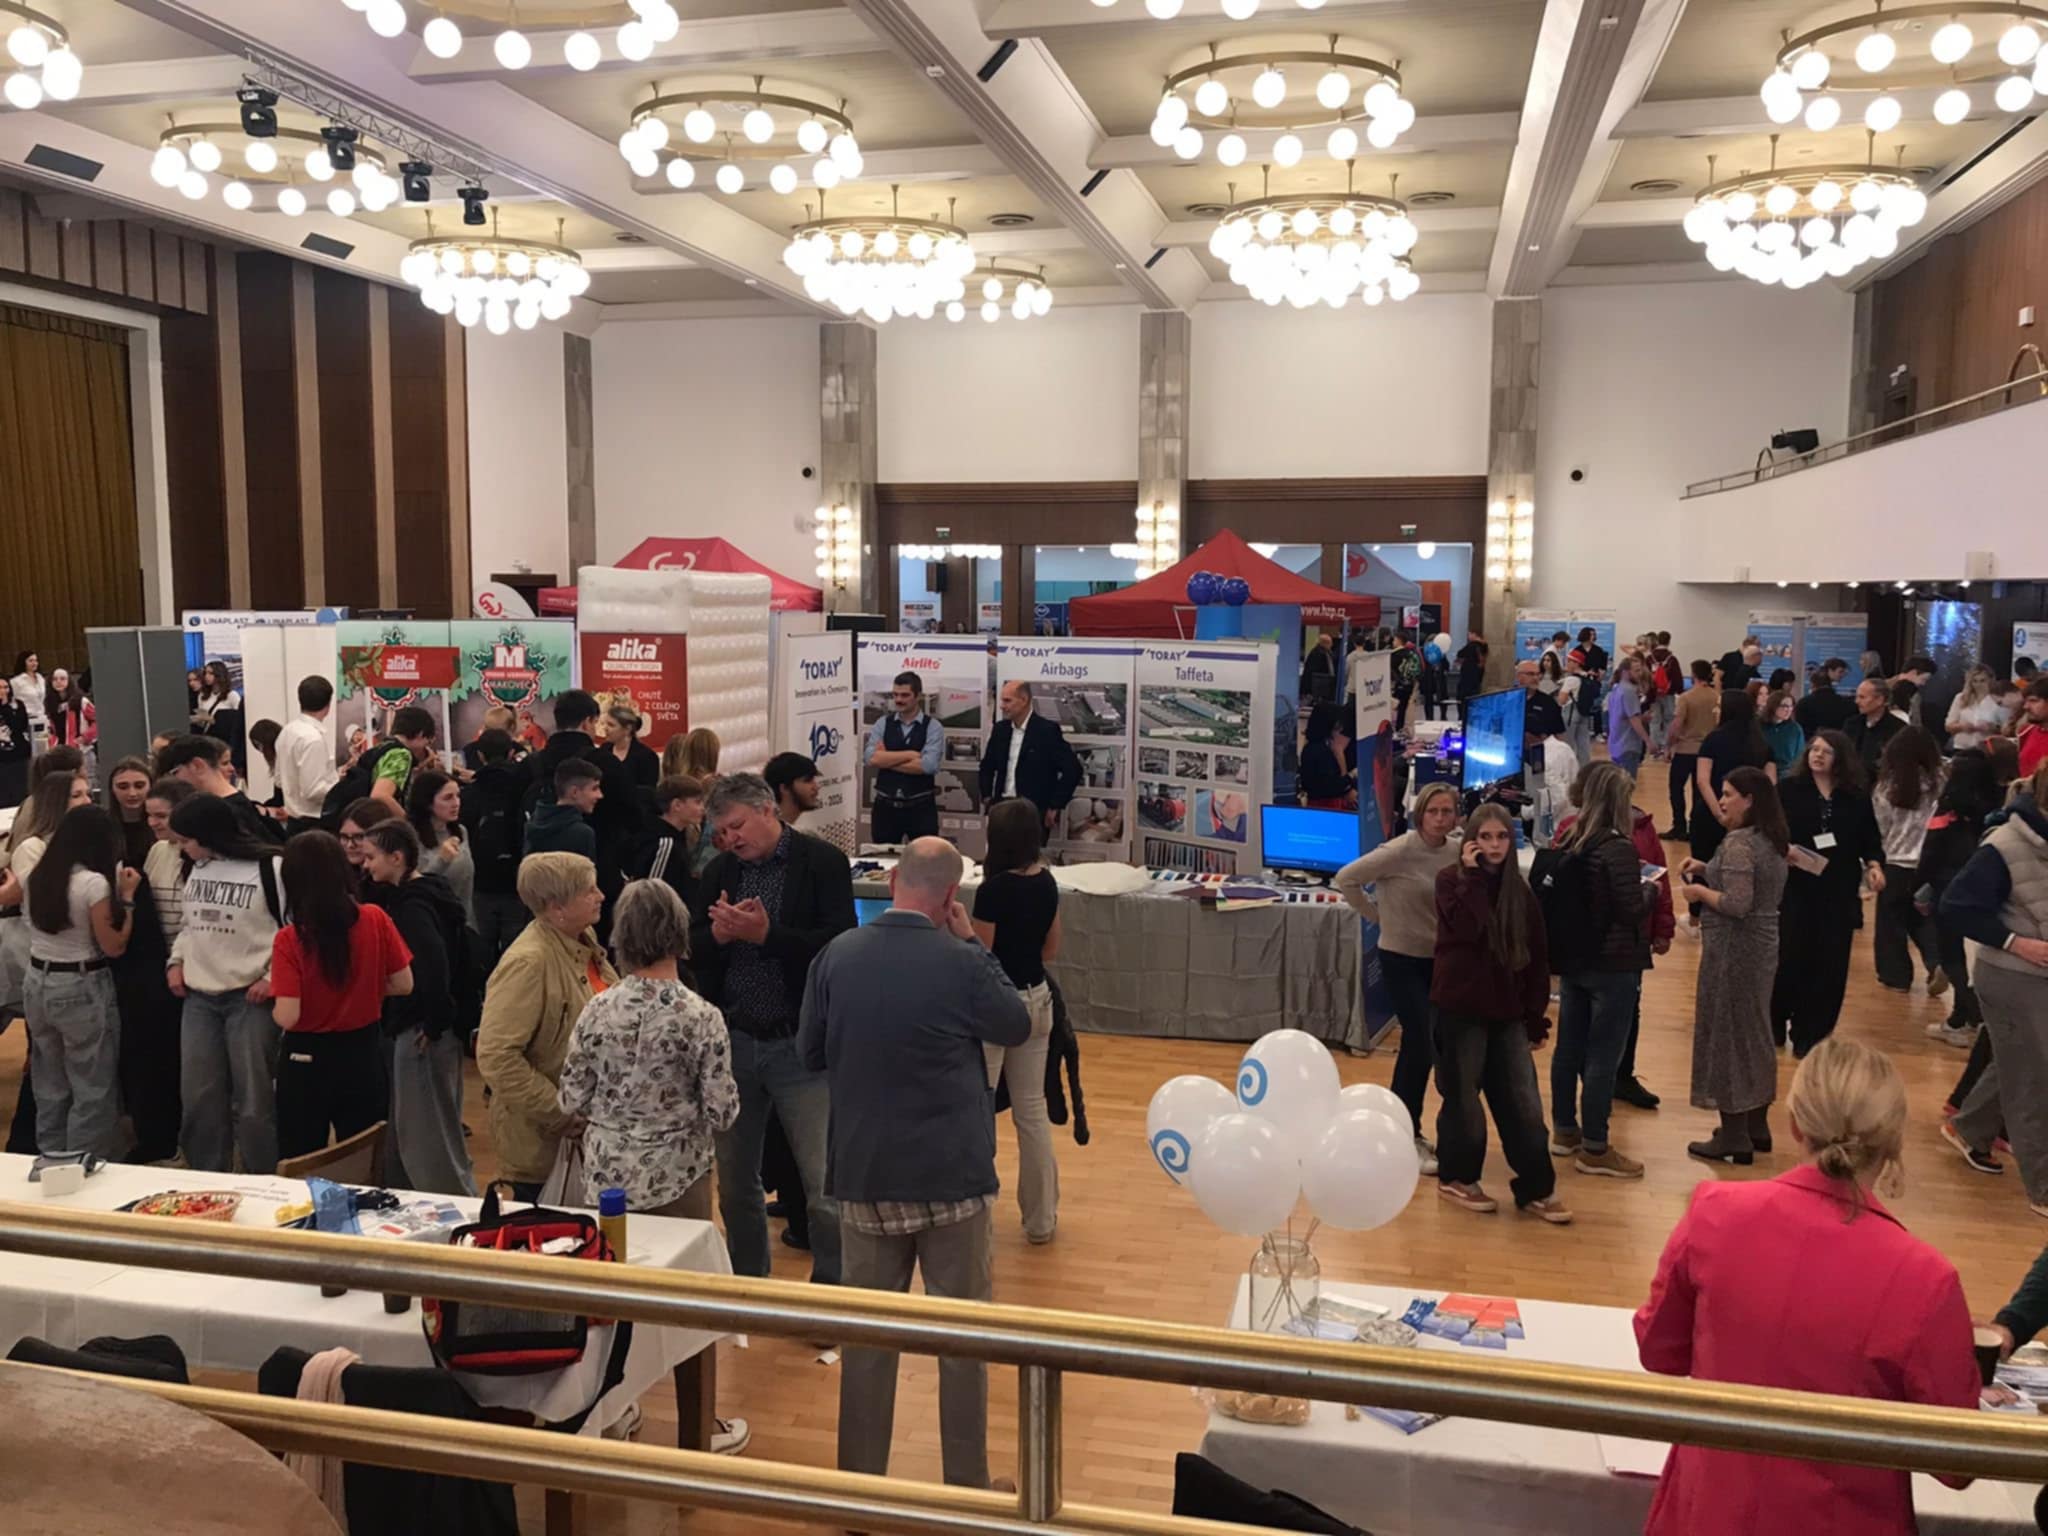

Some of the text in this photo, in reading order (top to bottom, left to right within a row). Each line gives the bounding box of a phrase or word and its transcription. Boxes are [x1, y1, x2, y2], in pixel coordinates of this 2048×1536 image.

[607, 638, 657, 660] alika
[386, 654, 417, 671] alika
[1040, 662, 1089, 679] Airbags
[1175, 667, 1214, 683] Taffeta
